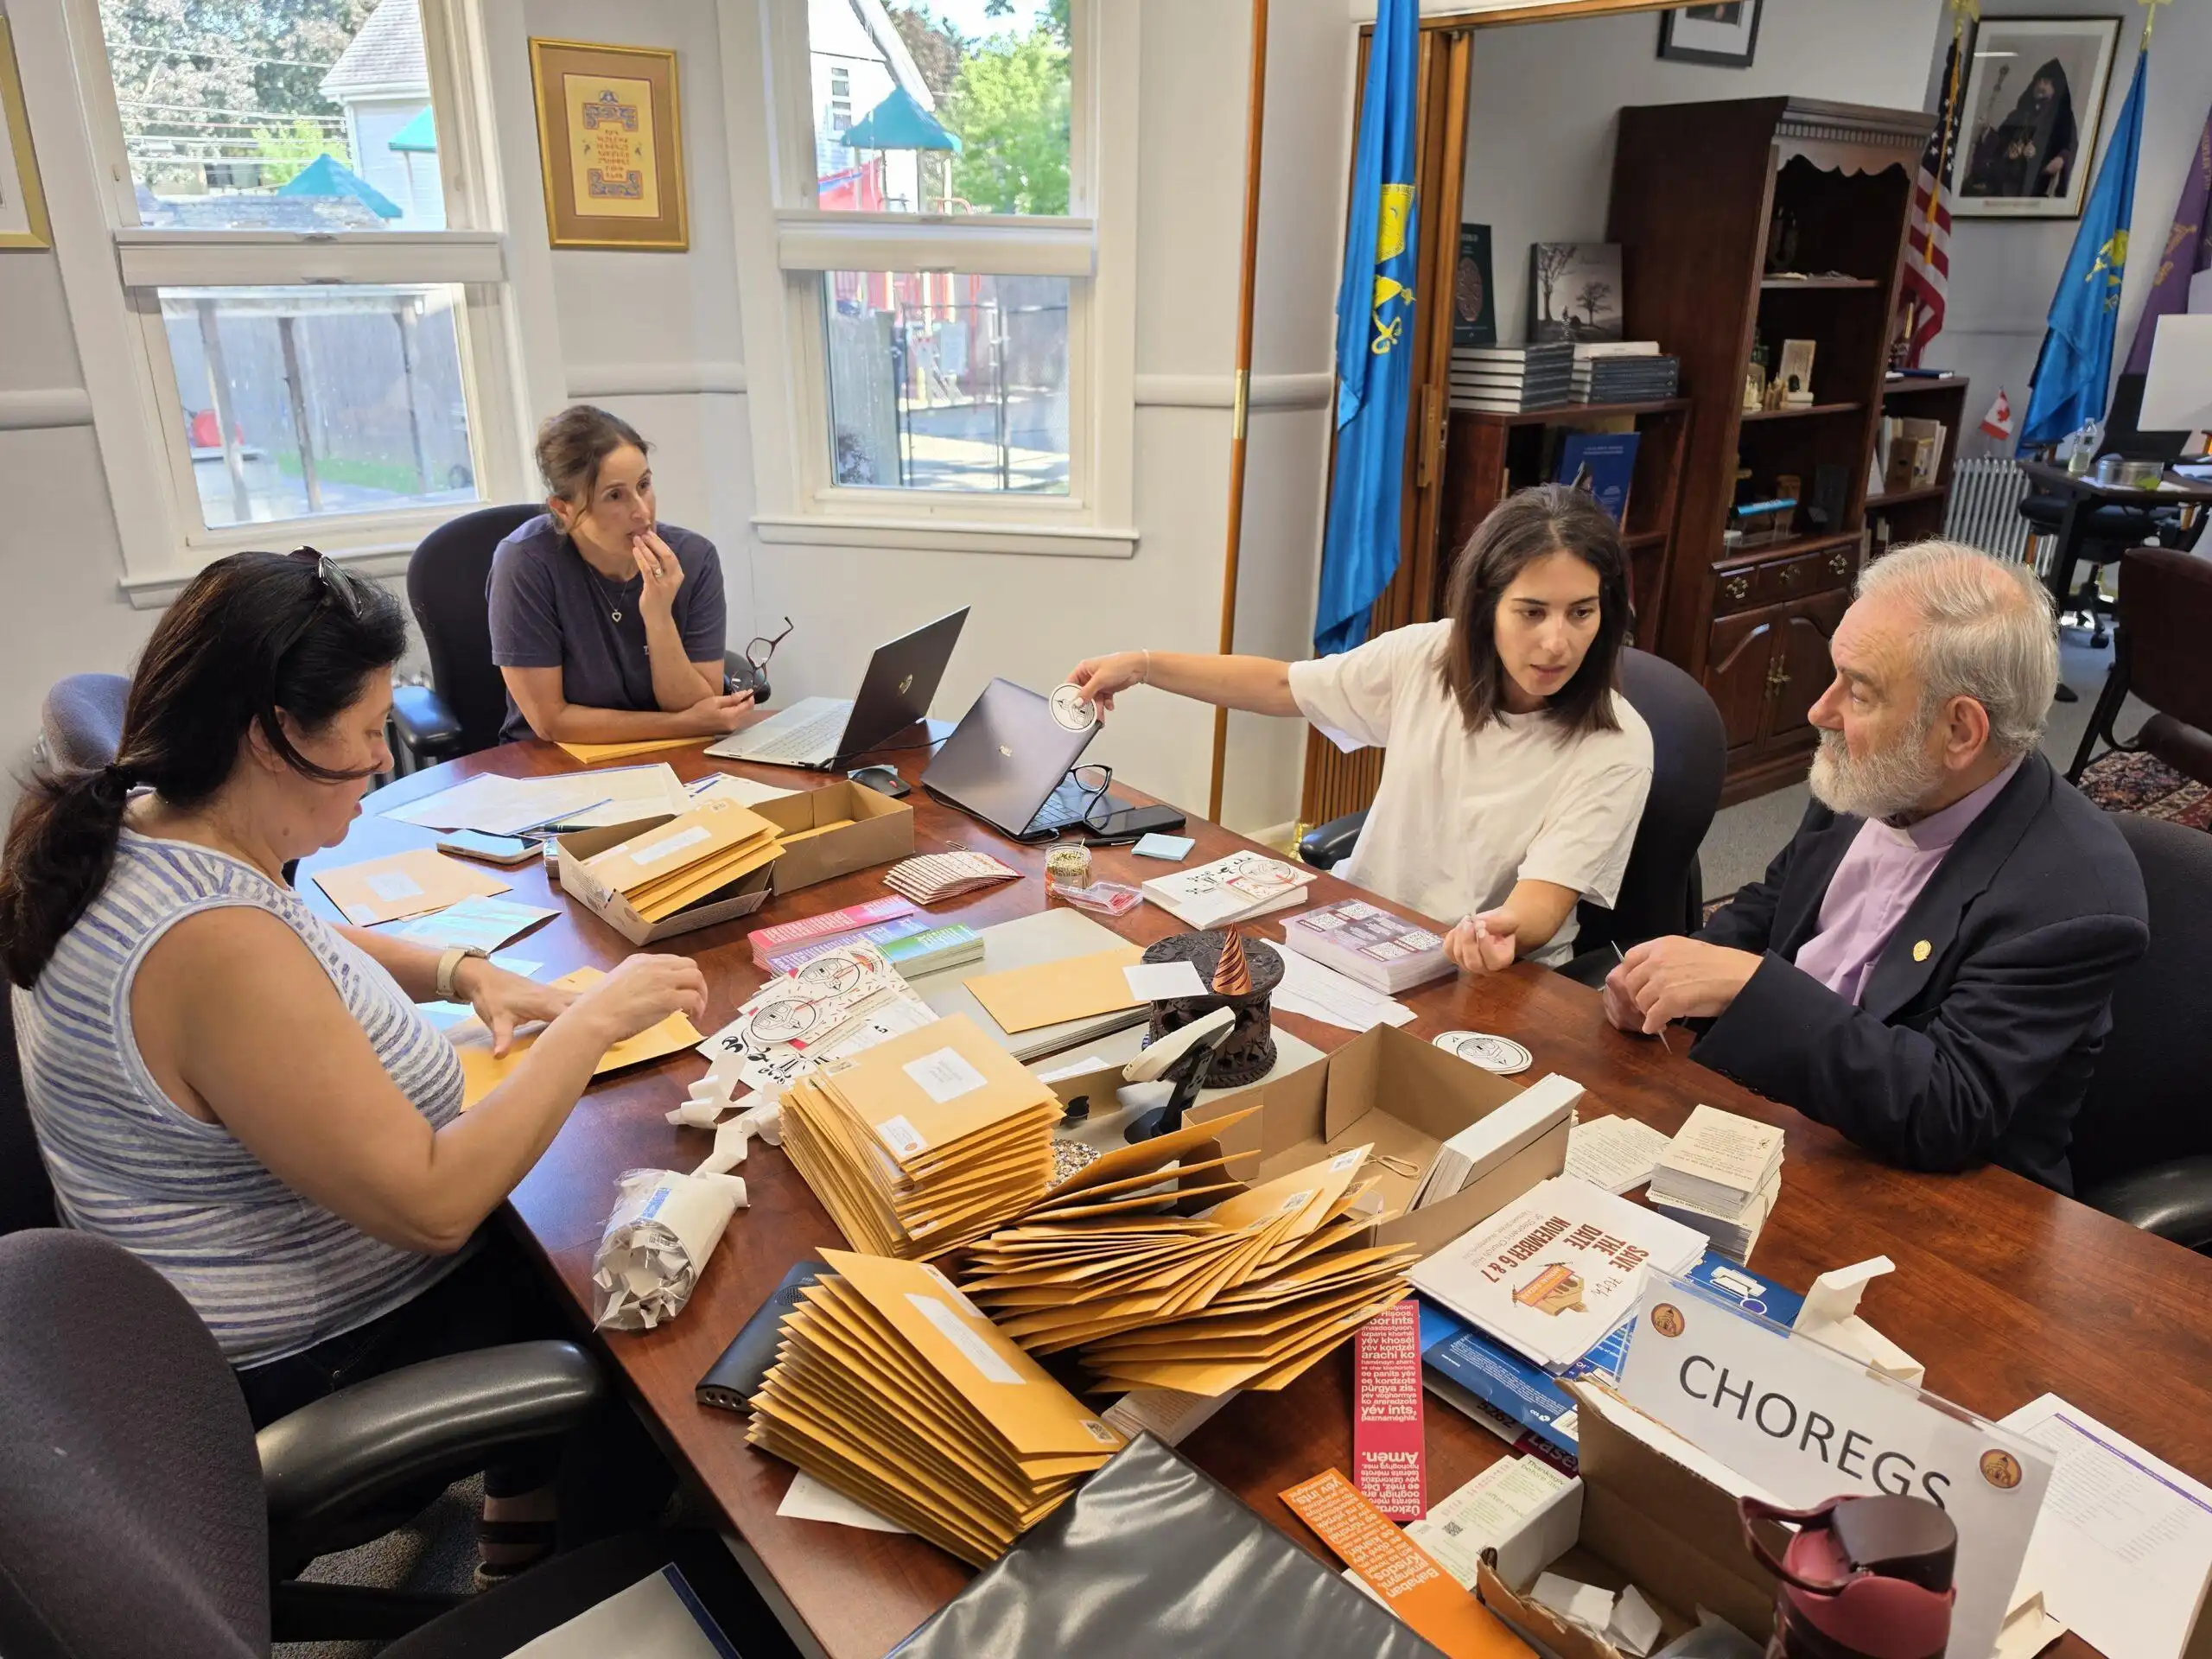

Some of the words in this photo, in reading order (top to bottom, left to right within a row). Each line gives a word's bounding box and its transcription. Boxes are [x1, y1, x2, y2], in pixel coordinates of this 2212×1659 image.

[1507, 1217, 1572, 1261] NOVEMBER
[1563, 1224, 1604, 1251] DATE
[1592, 1235, 1626, 1256] THE
[1498, 1255, 1518, 1268] 6
[1609, 1245, 1649, 1272] SAVE
[1488, 1262, 1507, 1274] &
[1481, 1269, 1500, 1283] 7
[1361, 1351, 1397, 1359] arachi
[1361, 1405, 1385, 1418] yév
[1388, 1405, 1417, 1415] ints,
[1679, 1355, 1951, 1511] CHOREGS
[1362, 1452, 1419, 1465] Amén.
[1376, 1504, 1421, 1516] Ûzkord
[1384, 1566, 1438, 1599] Bahaban
